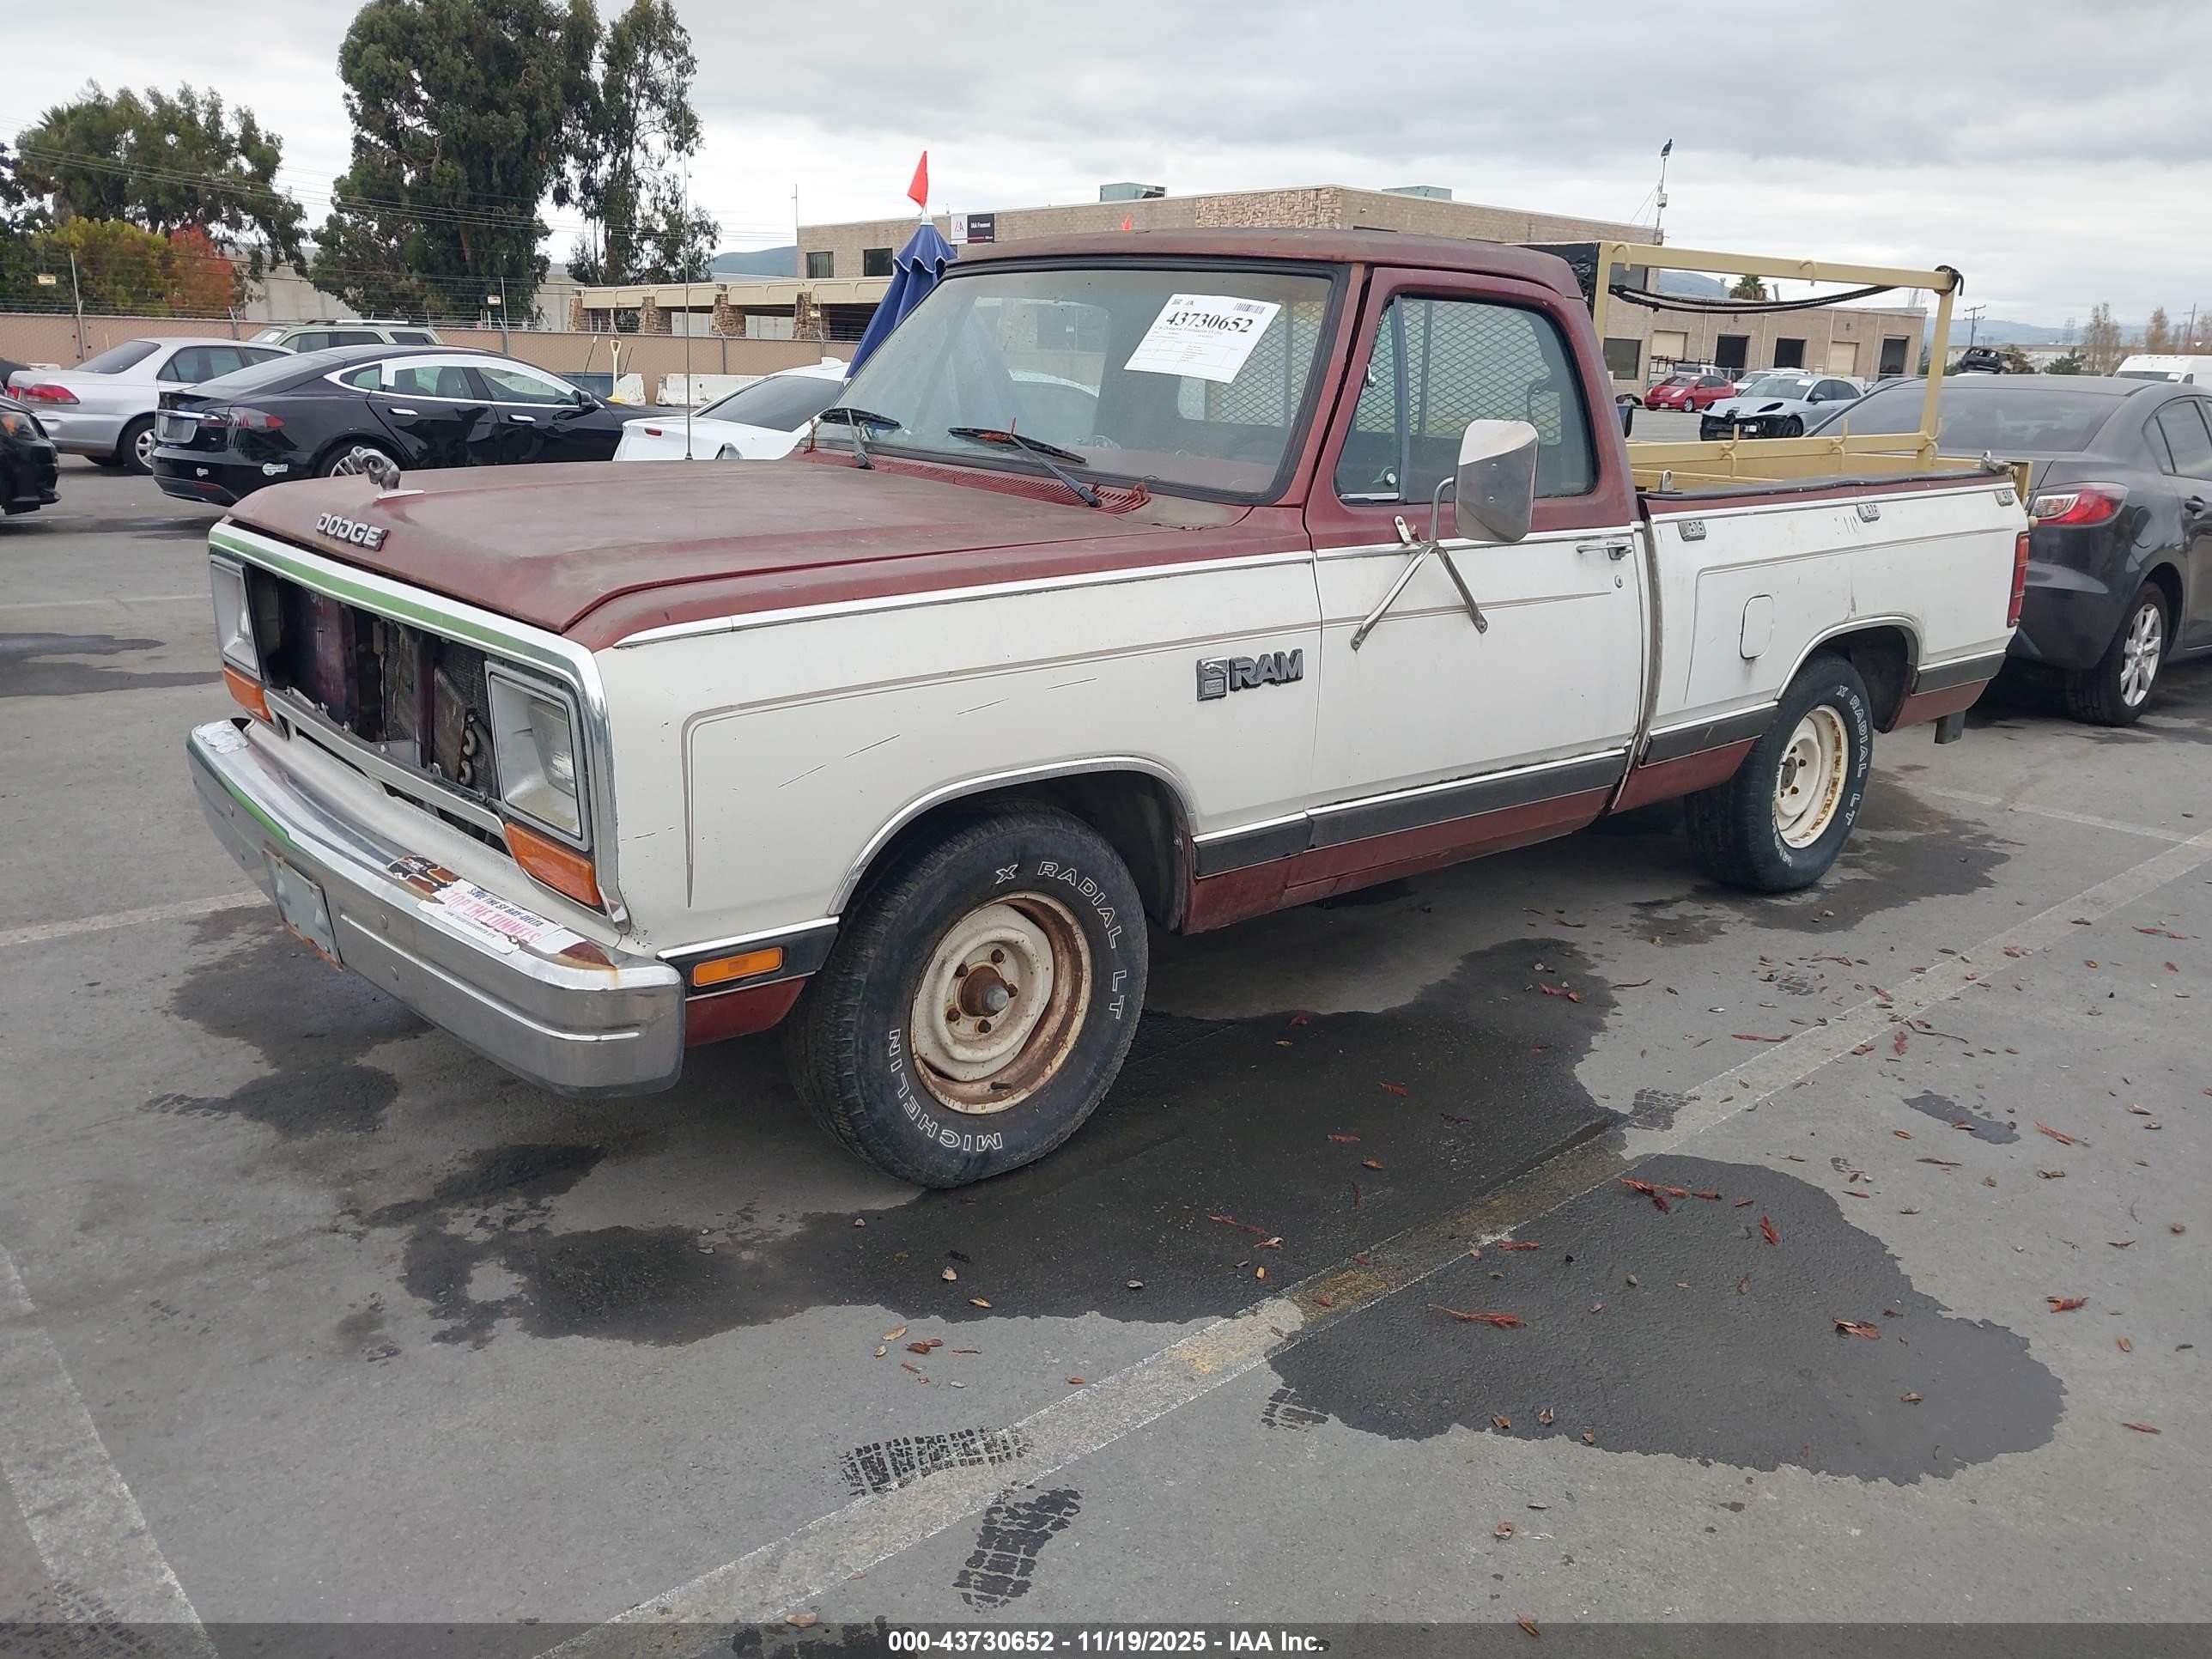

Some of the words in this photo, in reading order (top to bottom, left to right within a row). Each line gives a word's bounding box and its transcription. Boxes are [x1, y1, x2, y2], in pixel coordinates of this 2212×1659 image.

[1166, 311, 1254, 333] 43730652
[315, 512, 390, 551] DODGE
[1229, 648, 1304, 691] RAM
[1836, 685, 1848, 697] X
[1850, 695, 1868, 778] RADIAL
[1845, 793, 1861, 826] LT
[465, 902, 493, 918] THE
[483, 897, 501, 907] THE
[503, 908, 544, 927] BAY-DELTA
[995, 864, 1018, 884] X
[1037, 861, 1122, 949] RADIAL
[1109, 969, 1127, 1019] LT
[889, 1029, 1003, 1152] MICHELIN
